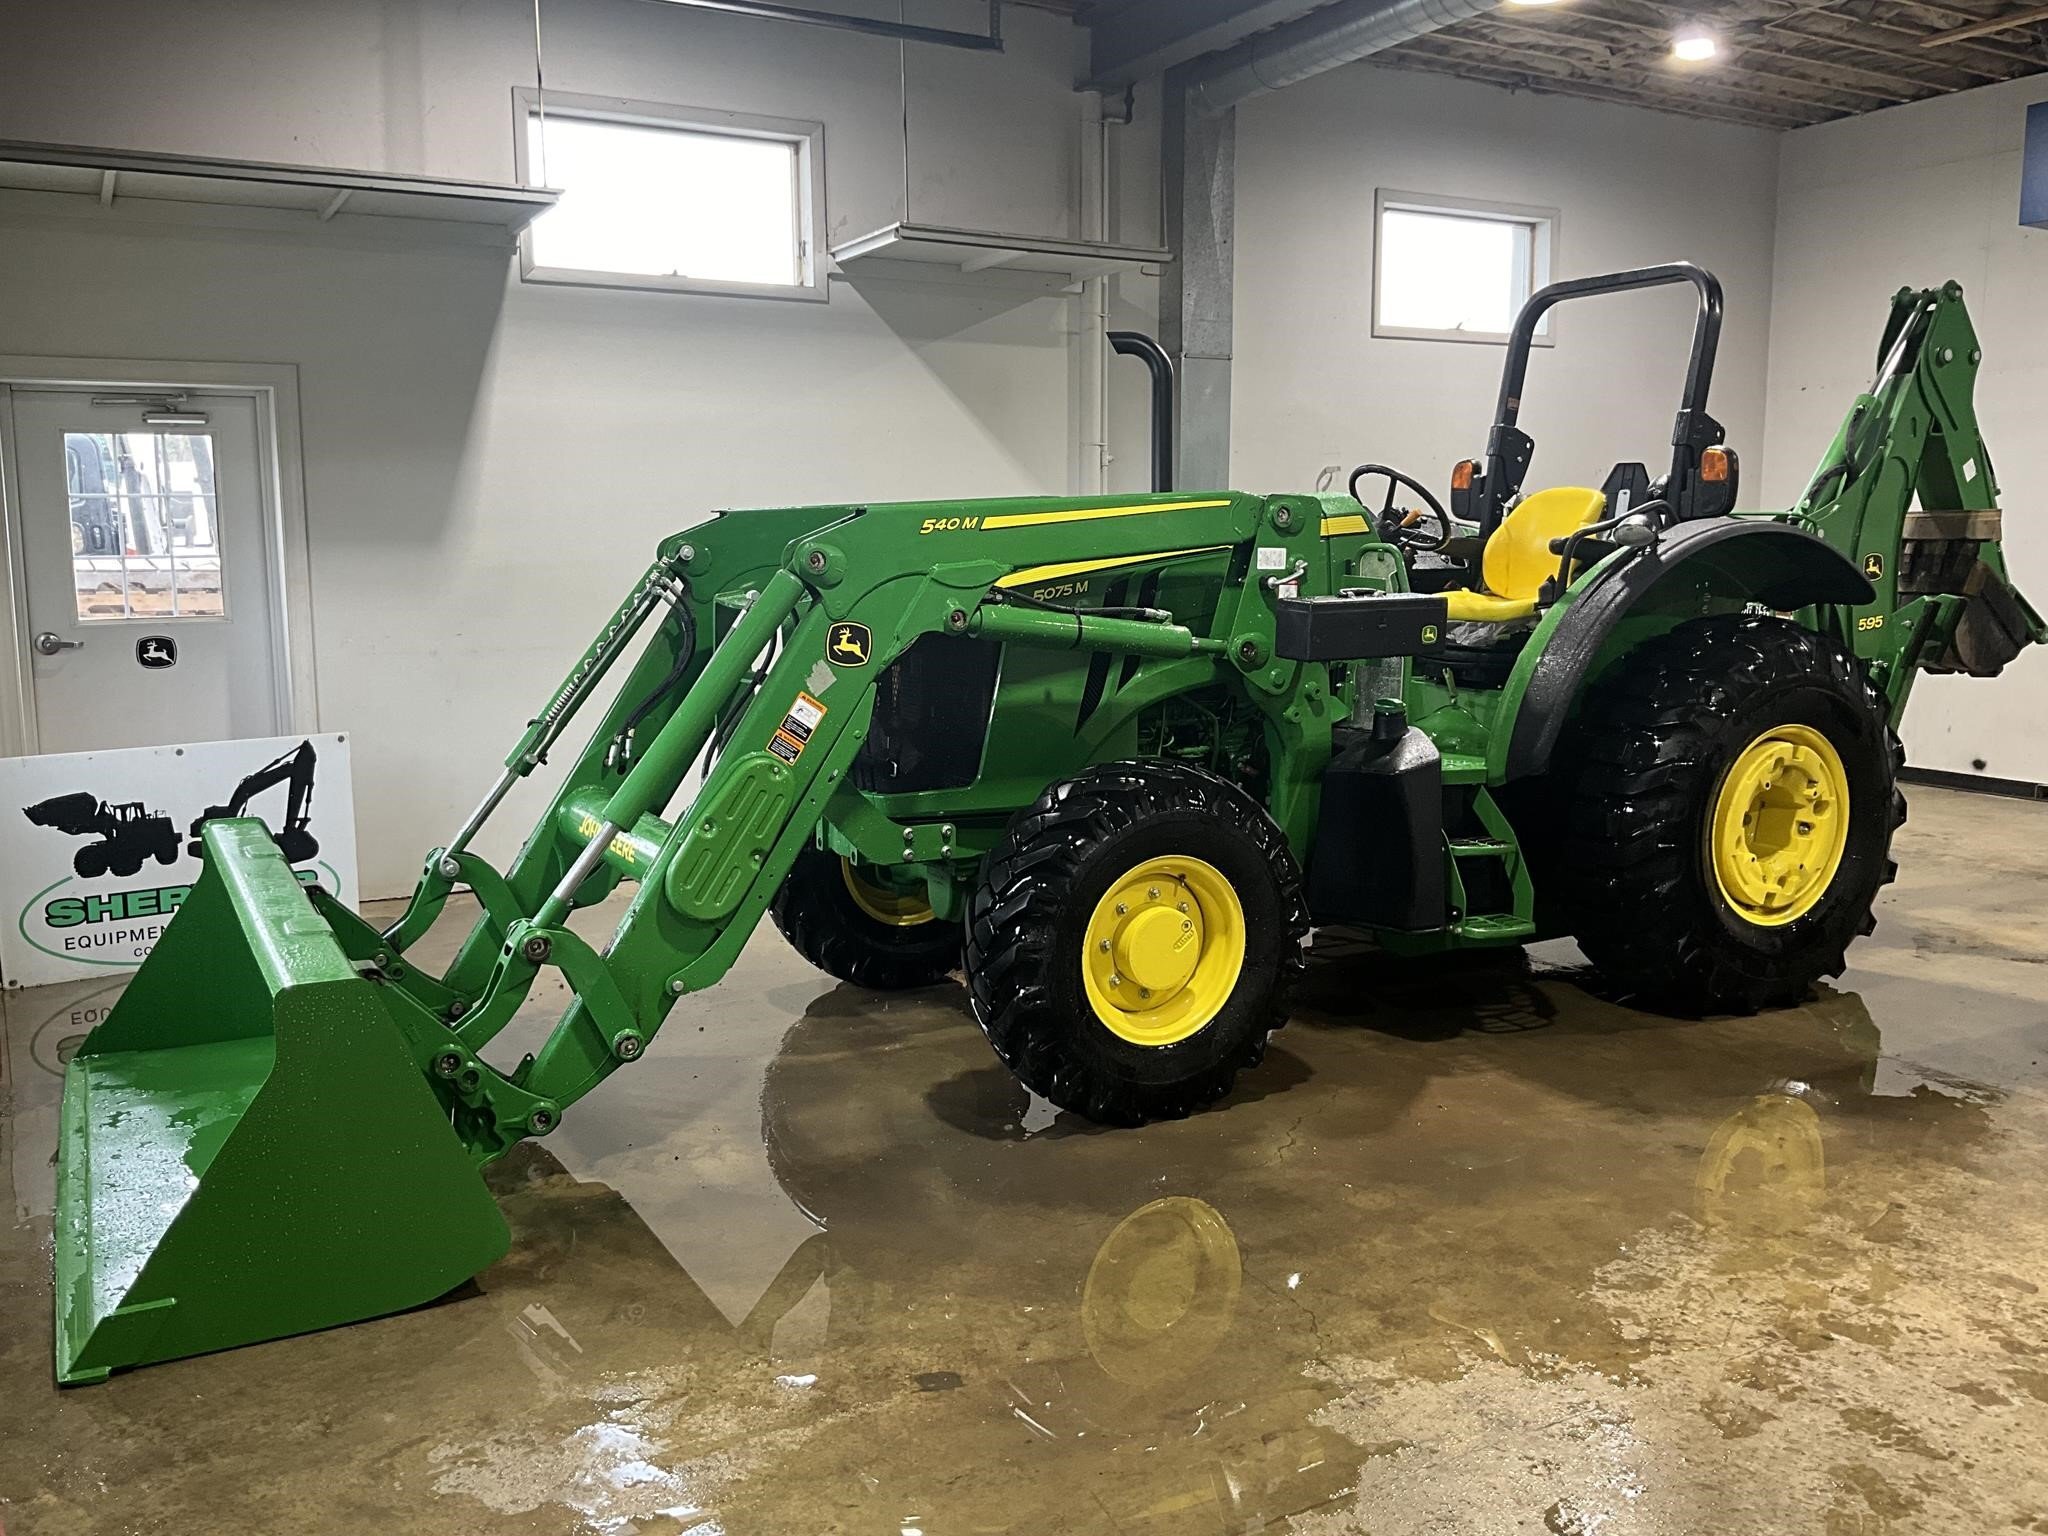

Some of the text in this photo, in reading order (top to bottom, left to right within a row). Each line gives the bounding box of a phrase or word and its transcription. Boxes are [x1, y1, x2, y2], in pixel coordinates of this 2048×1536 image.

[919, 516, 979, 535] 540 M
[1033, 580, 1089, 602] 5075 M
[1857, 615, 1884, 631] 595
